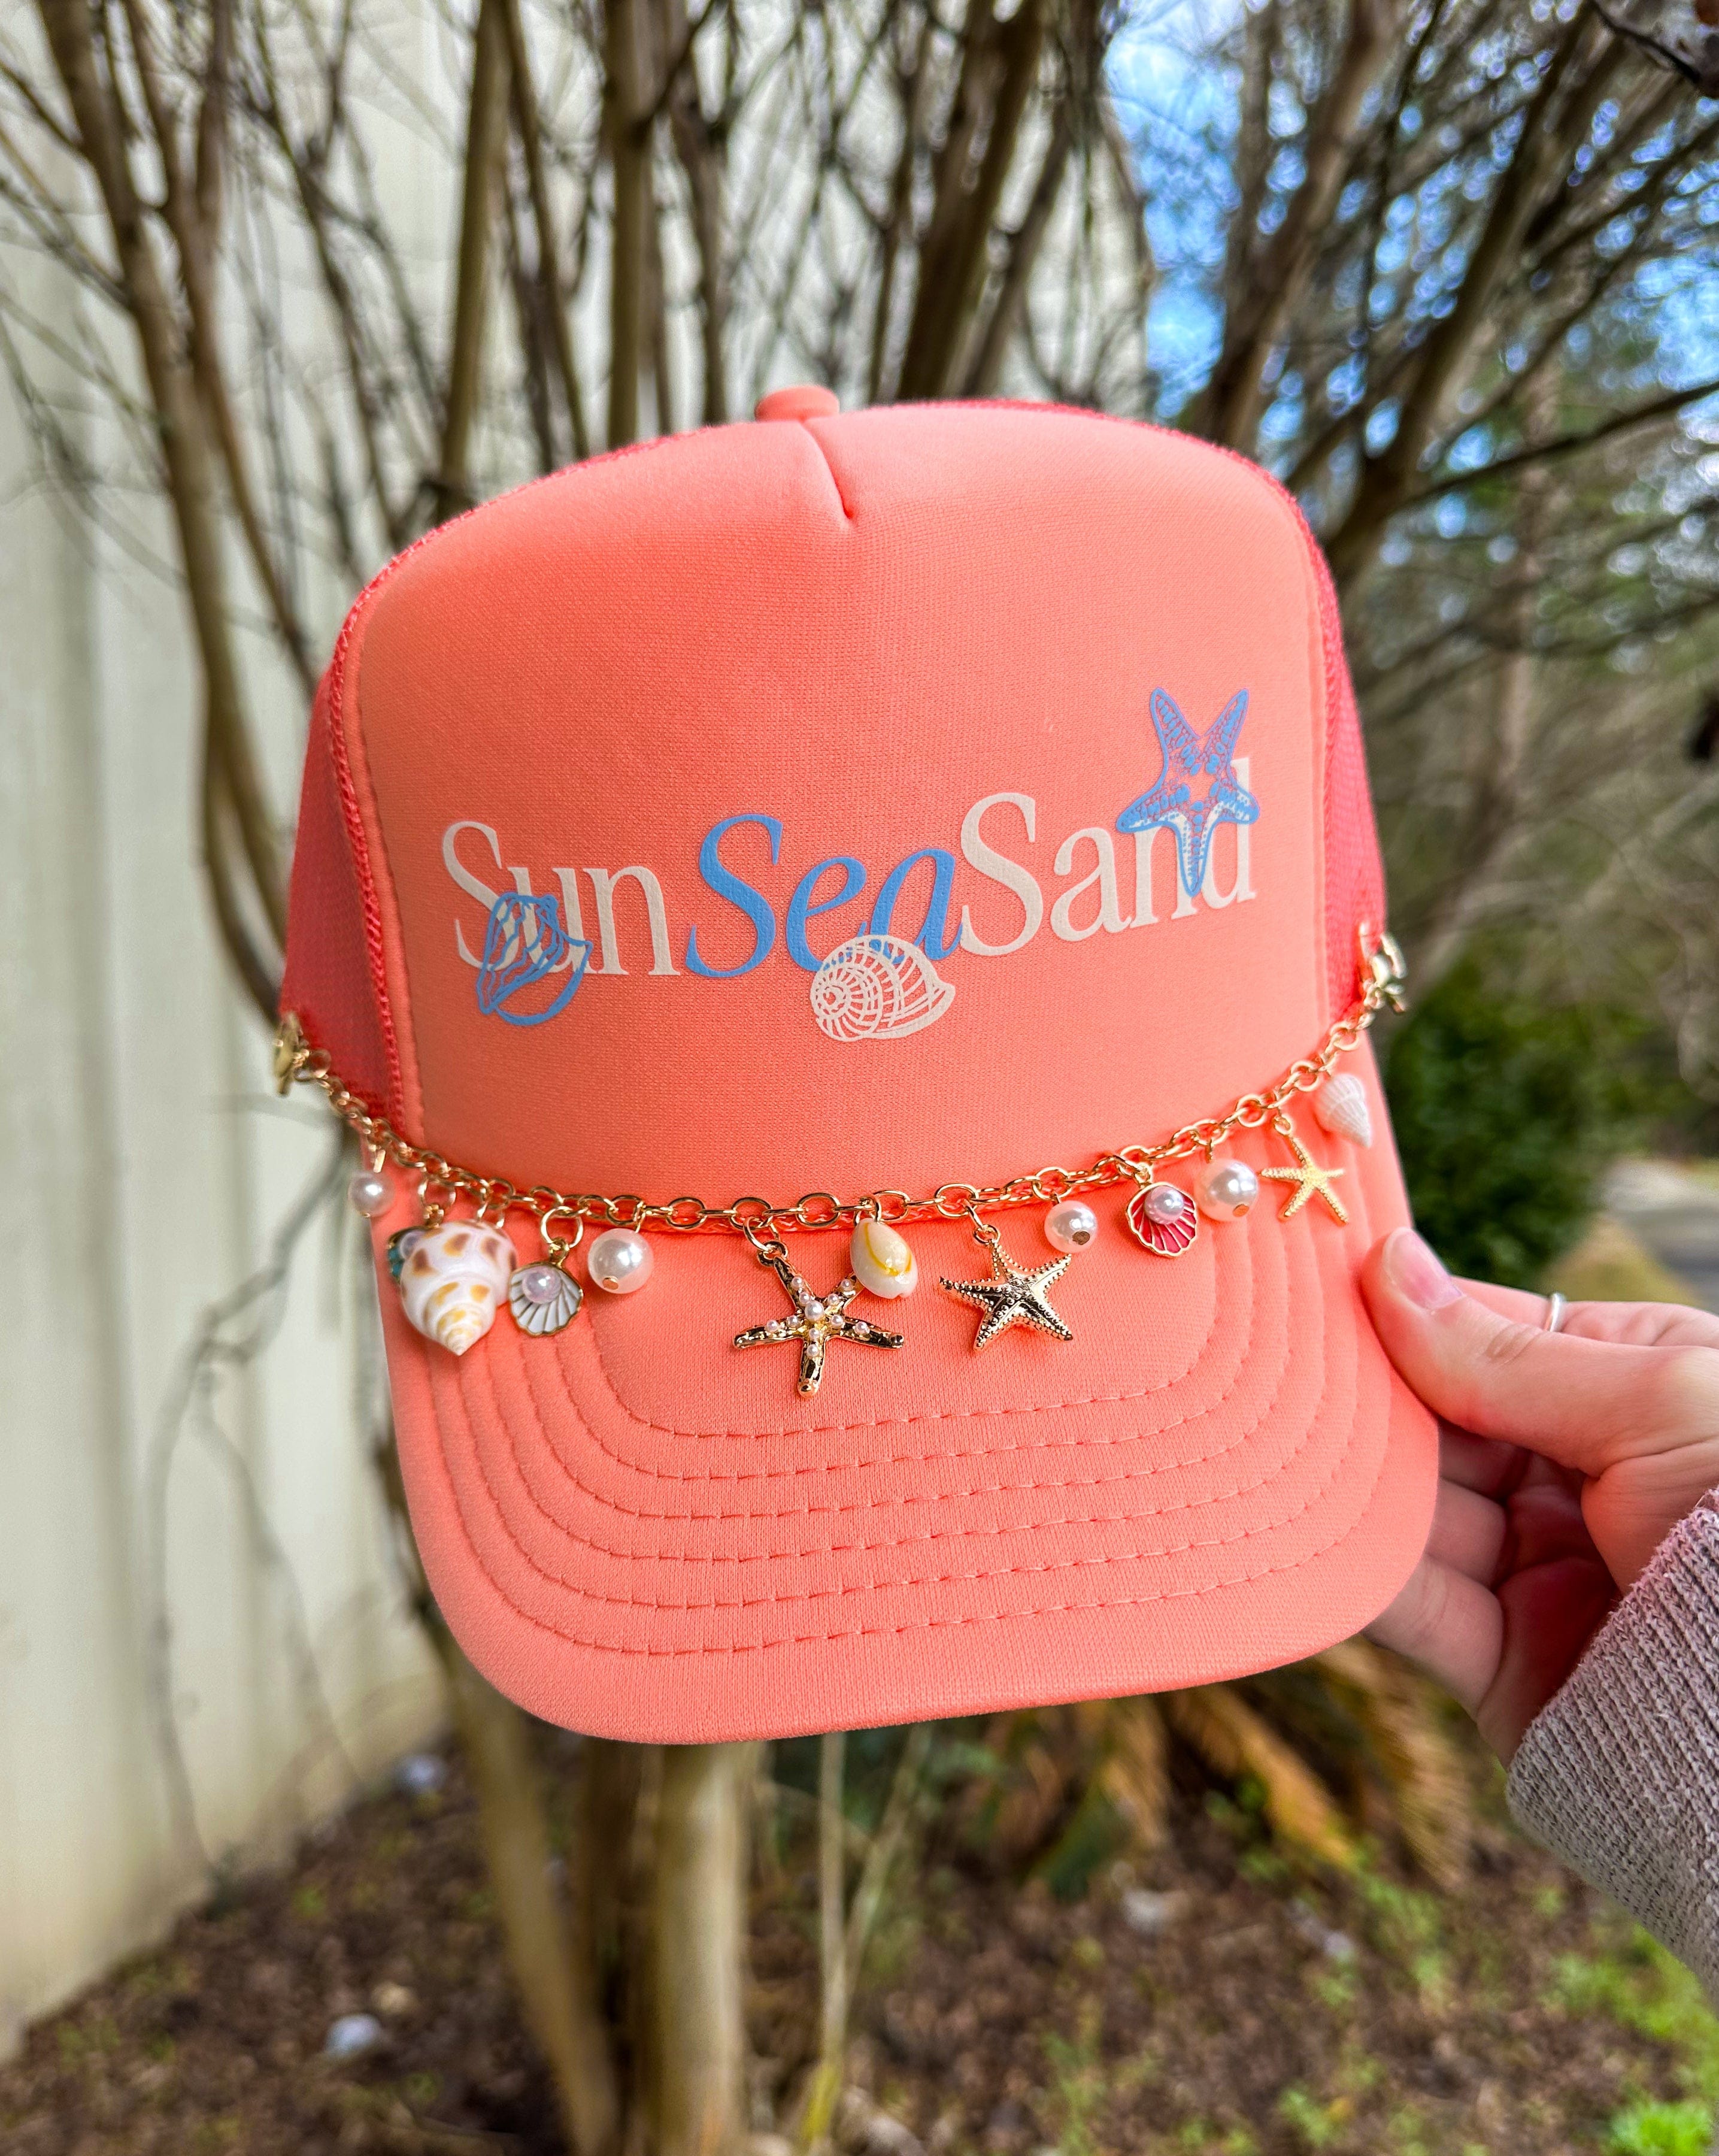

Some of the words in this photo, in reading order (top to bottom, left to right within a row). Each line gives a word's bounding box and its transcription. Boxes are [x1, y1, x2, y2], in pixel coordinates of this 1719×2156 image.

[441, 820, 681, 976] Sun
[685, 813, 963, 979] Sea
[960, 756, 1257, 956] Sand
